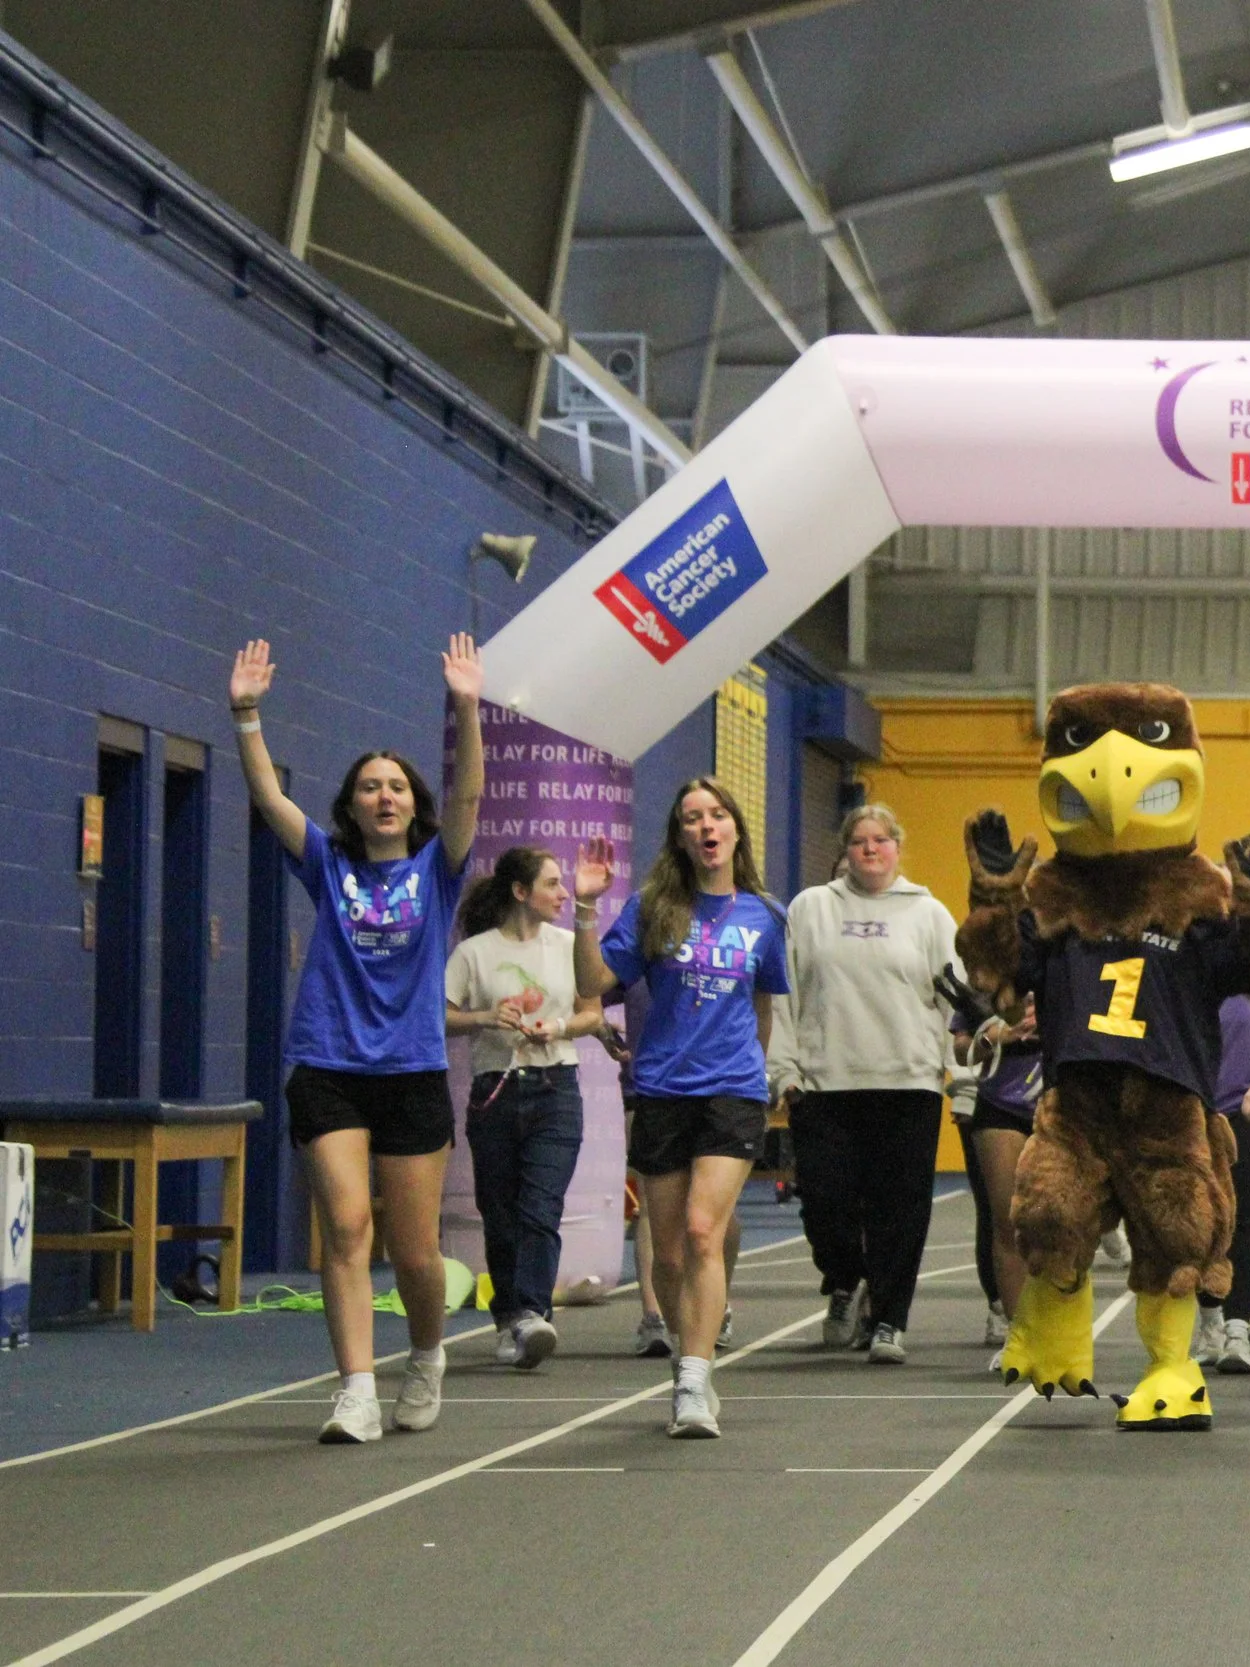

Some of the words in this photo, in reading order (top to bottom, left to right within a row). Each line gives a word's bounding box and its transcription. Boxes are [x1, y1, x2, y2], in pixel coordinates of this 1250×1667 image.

[644, 512, 731, 591] American
[655, 545, 719, 603] Cancer
[668, 556, 738, 618] Society
[483, 745, 526, 761] ELAY
[531, 745, 569, 761] FOR
[490, 782, 528, 799] LIFE
[538, 782, 595, 800] RELAY
[597, 784, 622, 802] FOR
[529, 820, 567, 837] FOR
[572, 821, 604, 838] LIFE
[685, 919, 762, 953] ELAY
[1141, 931, 1180, 952] TATE
[712, 947, 758, 973] LIFE
[1088, 957, 1147, 1039] 1
